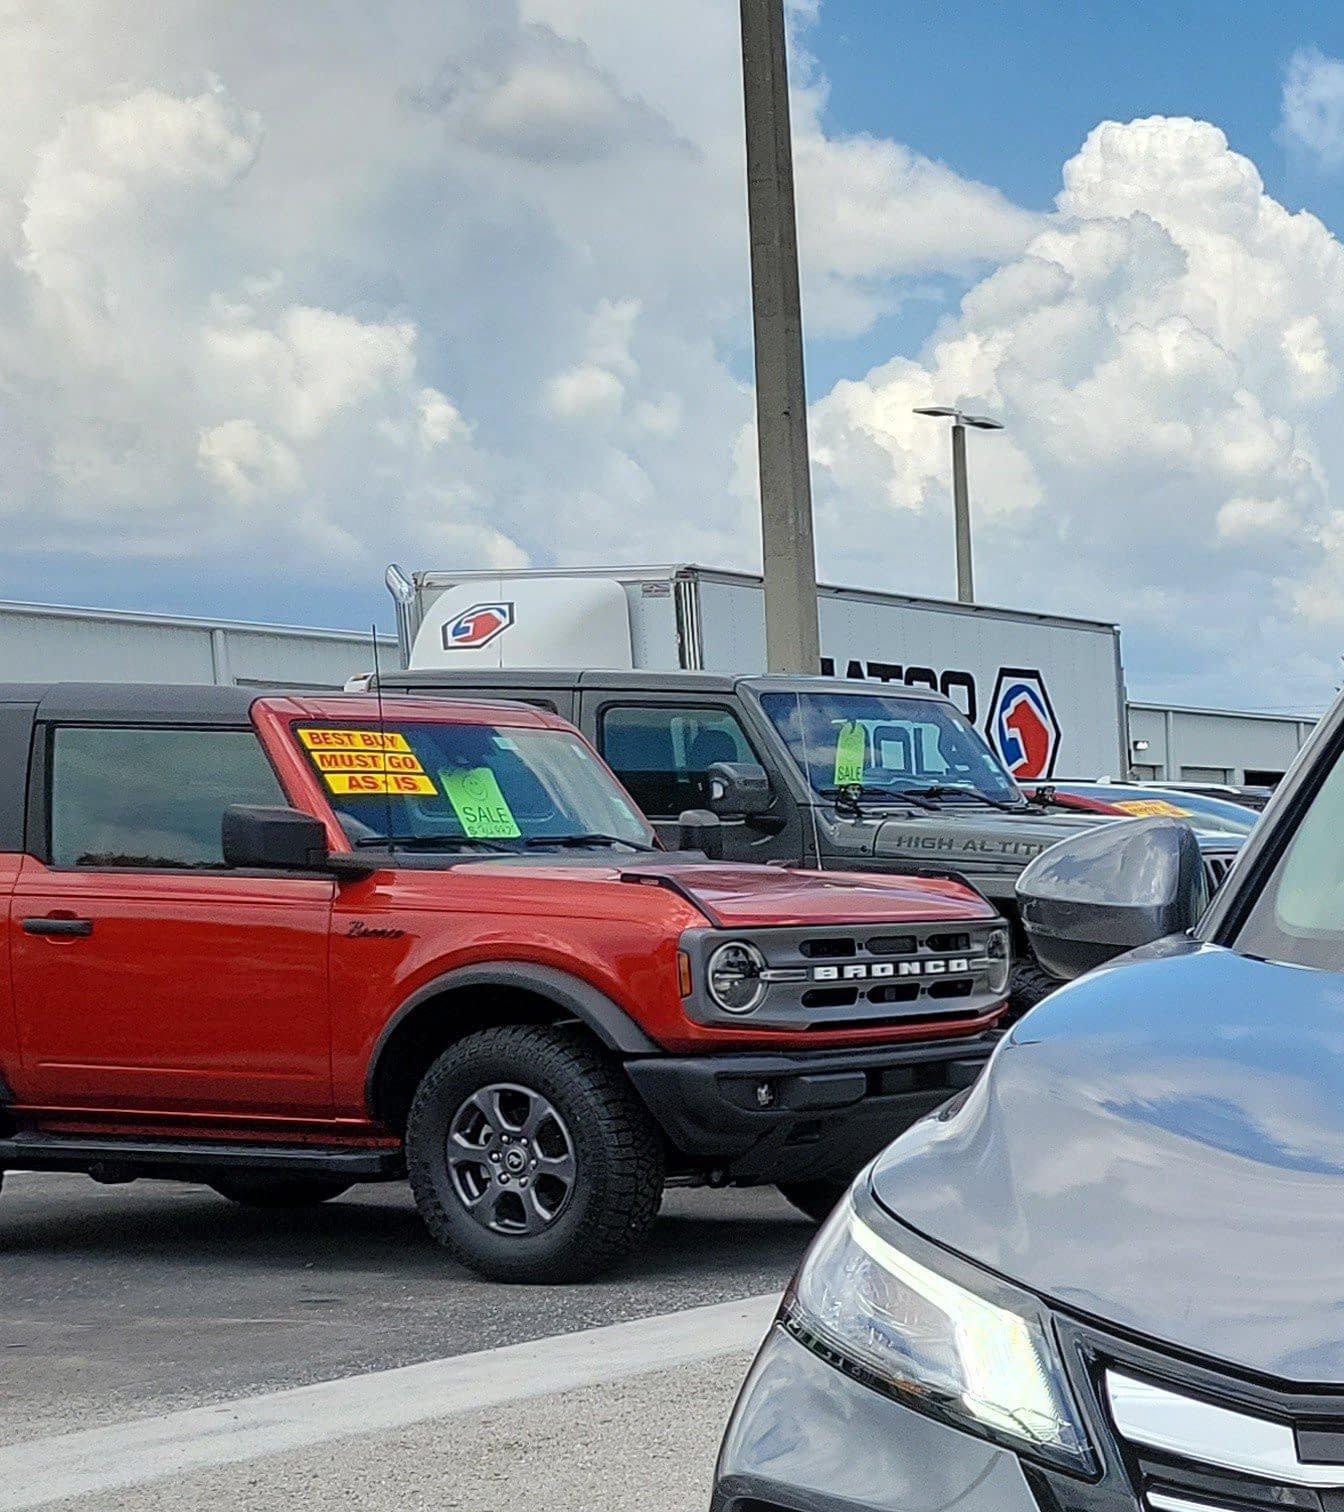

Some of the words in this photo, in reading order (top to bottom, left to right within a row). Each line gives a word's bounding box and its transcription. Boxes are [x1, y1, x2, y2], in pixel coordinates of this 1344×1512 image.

[309, 732, 354, 746] BEST
[360, 735, 397, 748] BUY
[320, 755, 379, 770] MUST
[388, 757, 416, 769] GO
[838, 765, 862, 781] SALE
[462, 806, 510, 823] SALE
[897, 836, 953, 850] HIGH
[813, 958, 969, 981] BRONCO
